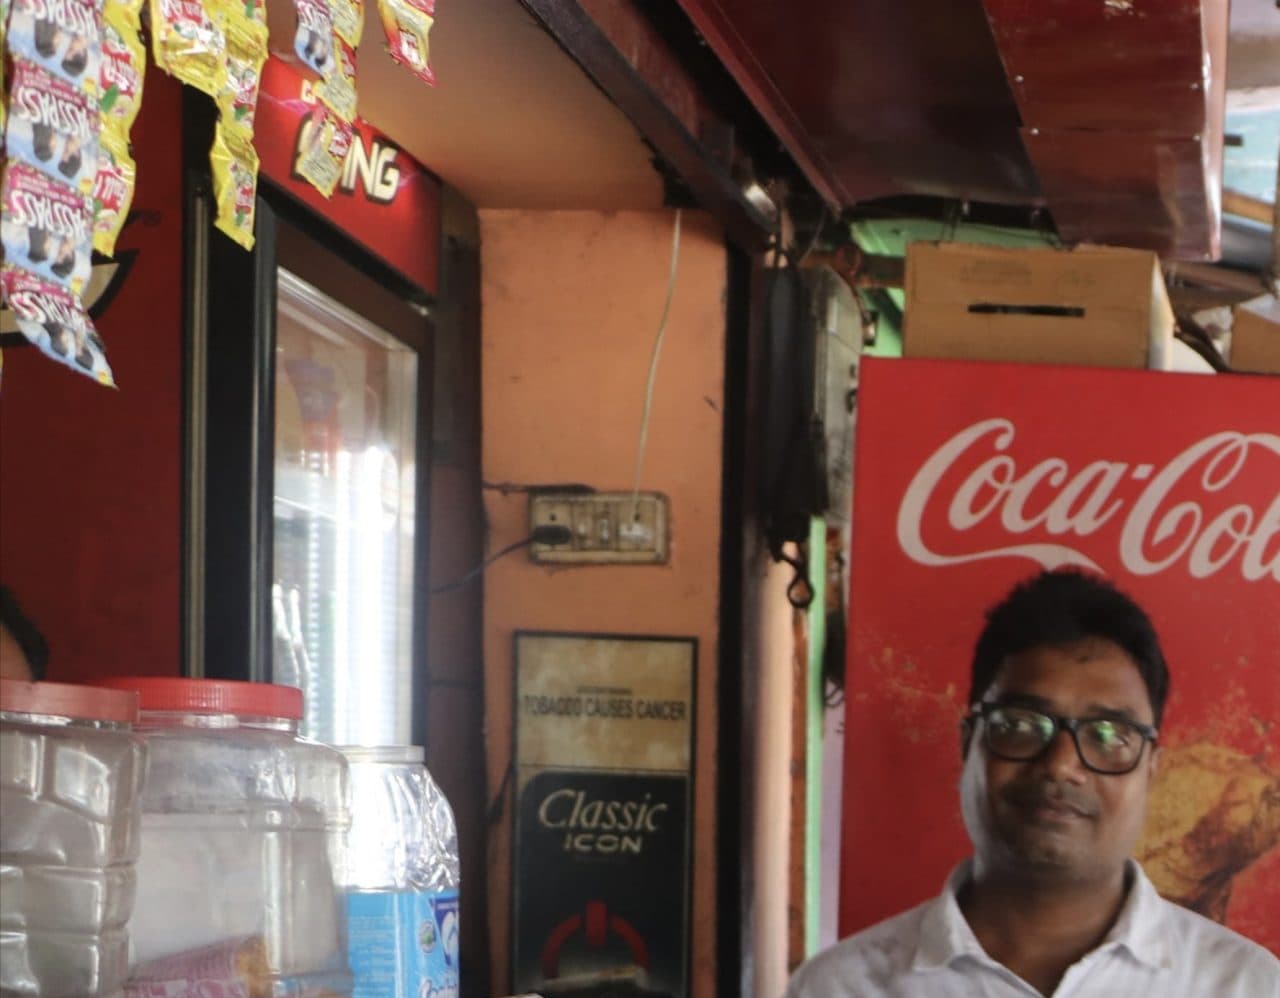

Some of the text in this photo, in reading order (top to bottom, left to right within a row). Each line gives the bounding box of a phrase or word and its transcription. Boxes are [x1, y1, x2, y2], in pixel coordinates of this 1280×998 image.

[525, 695, 686, 720] TOBACCO CAUSES CANCER
[538, 788, 668, 831] Classic
[564, 833, 643, 854] ICON
